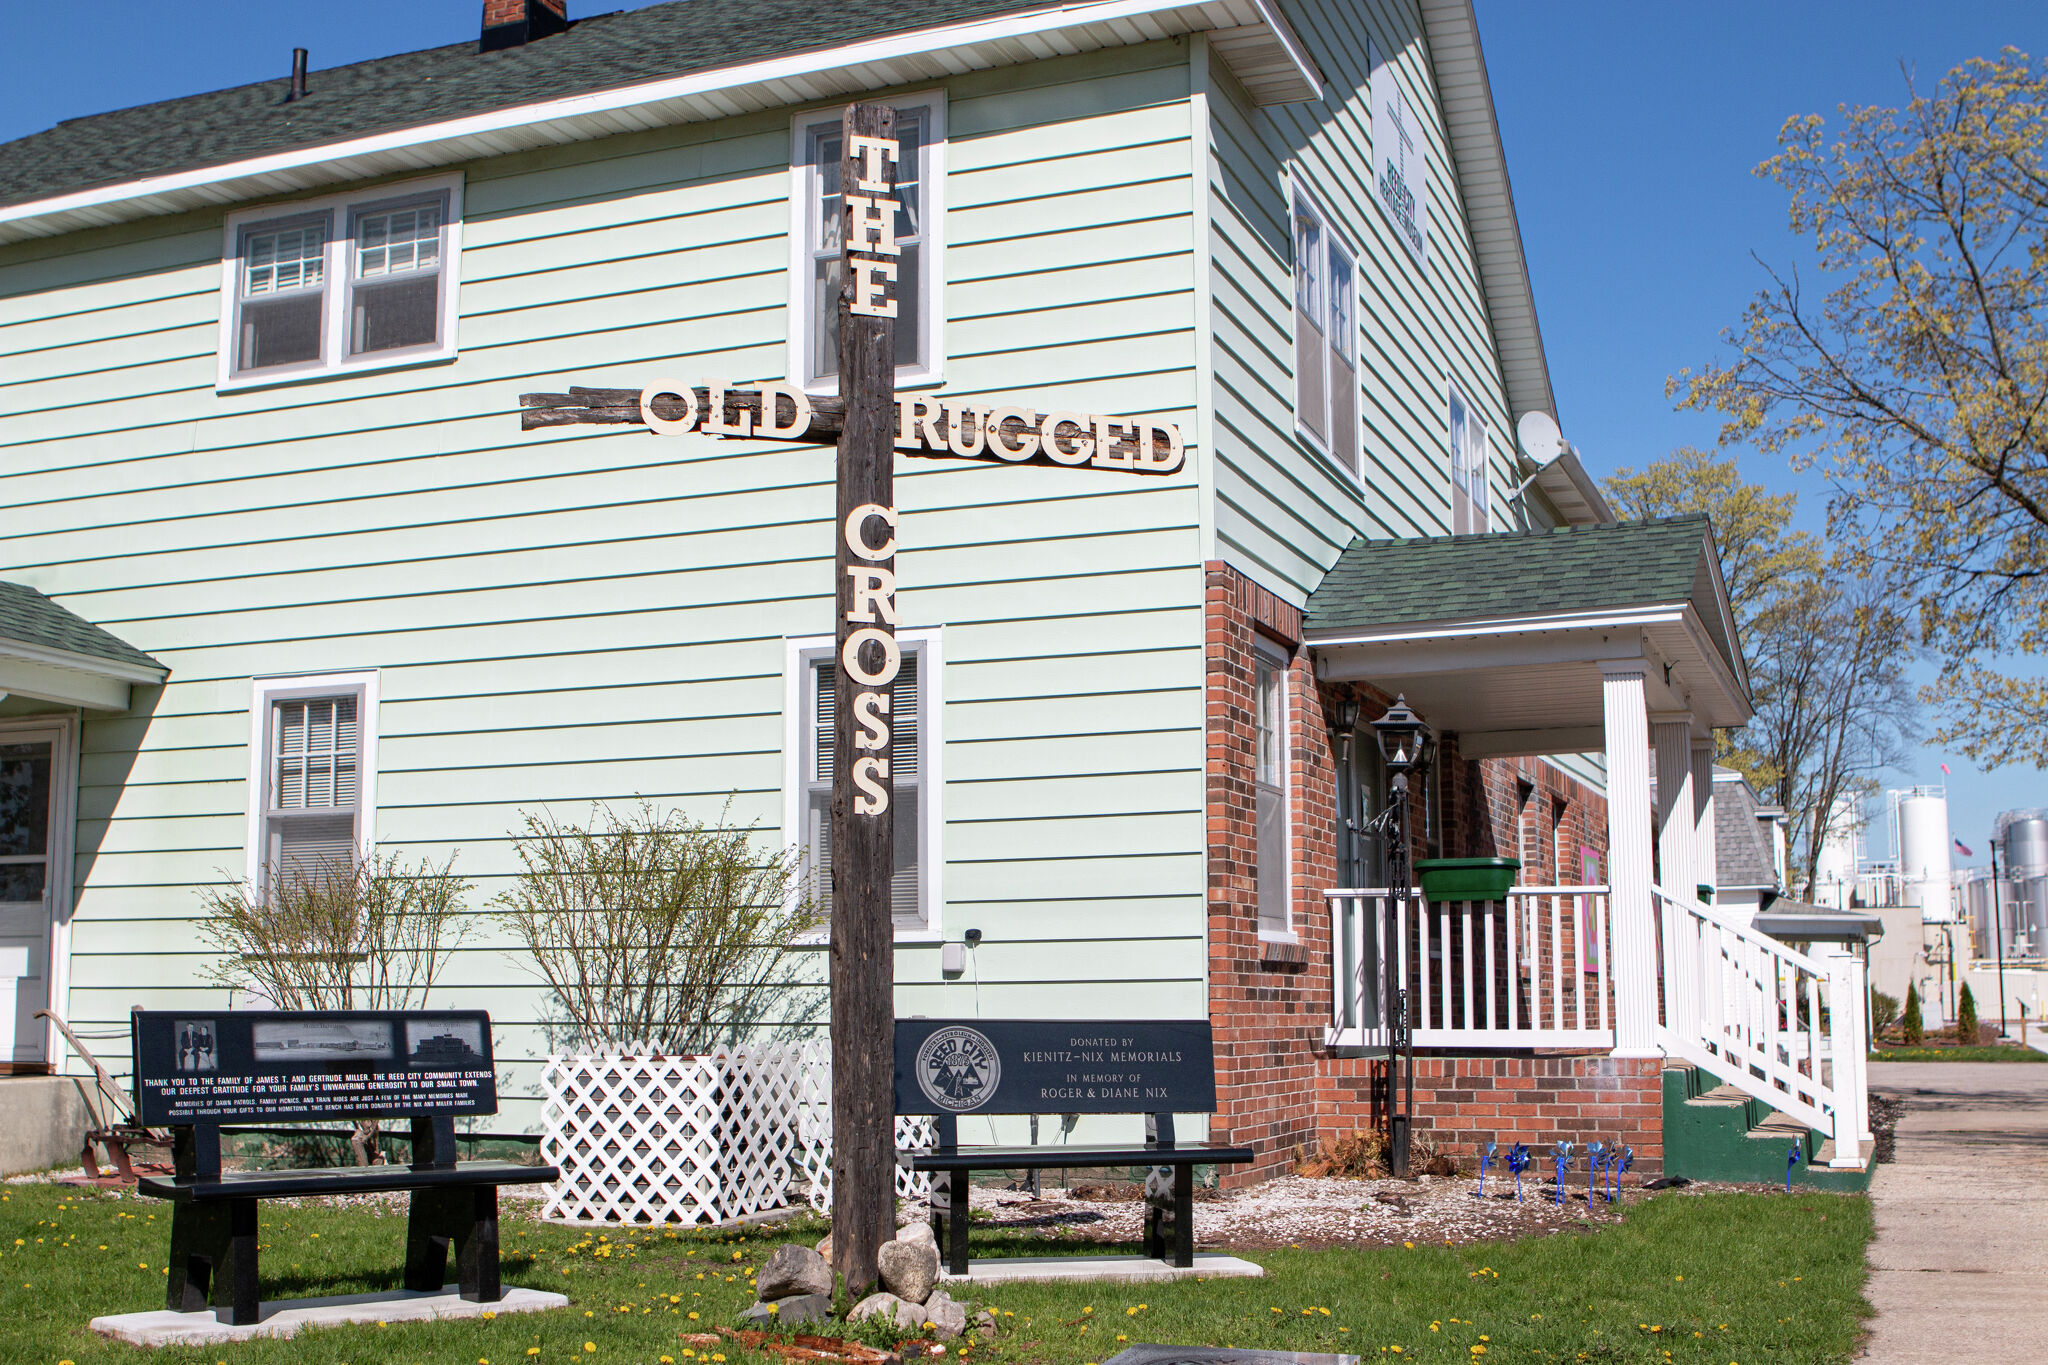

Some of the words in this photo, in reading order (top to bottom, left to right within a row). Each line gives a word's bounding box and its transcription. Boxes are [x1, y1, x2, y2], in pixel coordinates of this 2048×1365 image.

[1386, 156, 1400, 201] REED
[846, 135, 901, 318] THE
[640, 378, 811, 439] OLD
[899, 394, 1185, 472] RUGGED
[843, 504, 902, 816] CROSS
[1071, 1038, 1117, 1046] DONATED
[1122, 1038, 1133, 1046] BY
[929, 1039, 957, 1069] REED
[962, 1039, 988, 1069] CITY
[1023, 1052, 1104, 1062] KIENITZ-NIX
[1111, 1052, 1182, 1062] MEMORIALS
[144, 1079, 168, 1087] THANK
[171, 1078, 185, 1086] YOU
[217, 1077, 241, 1085] FAMILY
[256, 1076, 279, 1084] JAMES
[291, 1075, 306, 1083] AND
[308, 1074, 342, 1083] GERTRUDE
[346, 1074, 370, 1082] MILLER.
[373, 1073, 385, 1081] THE
[388, 1073, 405, 1081] REED
[407, 1072, 421, 1080] CITY
[424, 1071, 462, 1080] COMMUNITY
[465, 1071, 492, 1079] EXTENDS
[1067, 1074, 1076, 1083] IN
[1083, 1074, 1124, 1083] MEMORY
[1129, 1074, 1141, 1083] OF
[161, 1087, 176, 1096] OUR
[180, 1087, 209, 1095] DEEPEST
[212, 1086, 249, 1094] GRATITUDE
[252, 1085, 266, 1093] FOR
[269, 1085, 287, 1093] YOUR
[290, 1084, 320, 1092] FAMILY'S
[322, 1083, 366, 1091] UNWAVERING
[368, 1081, 407, 1090] GENEROSITY
[410, 1081, 418, 1089] TO
[437, 1080, 457, 1088] SMALL
[1041, 1088, 1083, 1098] ROGER
[1087, 1088, 1096, 1098] &
[1102, 1088, 1139, 1098] DIANE
[1146, 1088, 1167, 1098] NIX
[174, 1100, 204, 1108] MEMORIES
[937, 1094, 981, 1108] MICHIGAN
